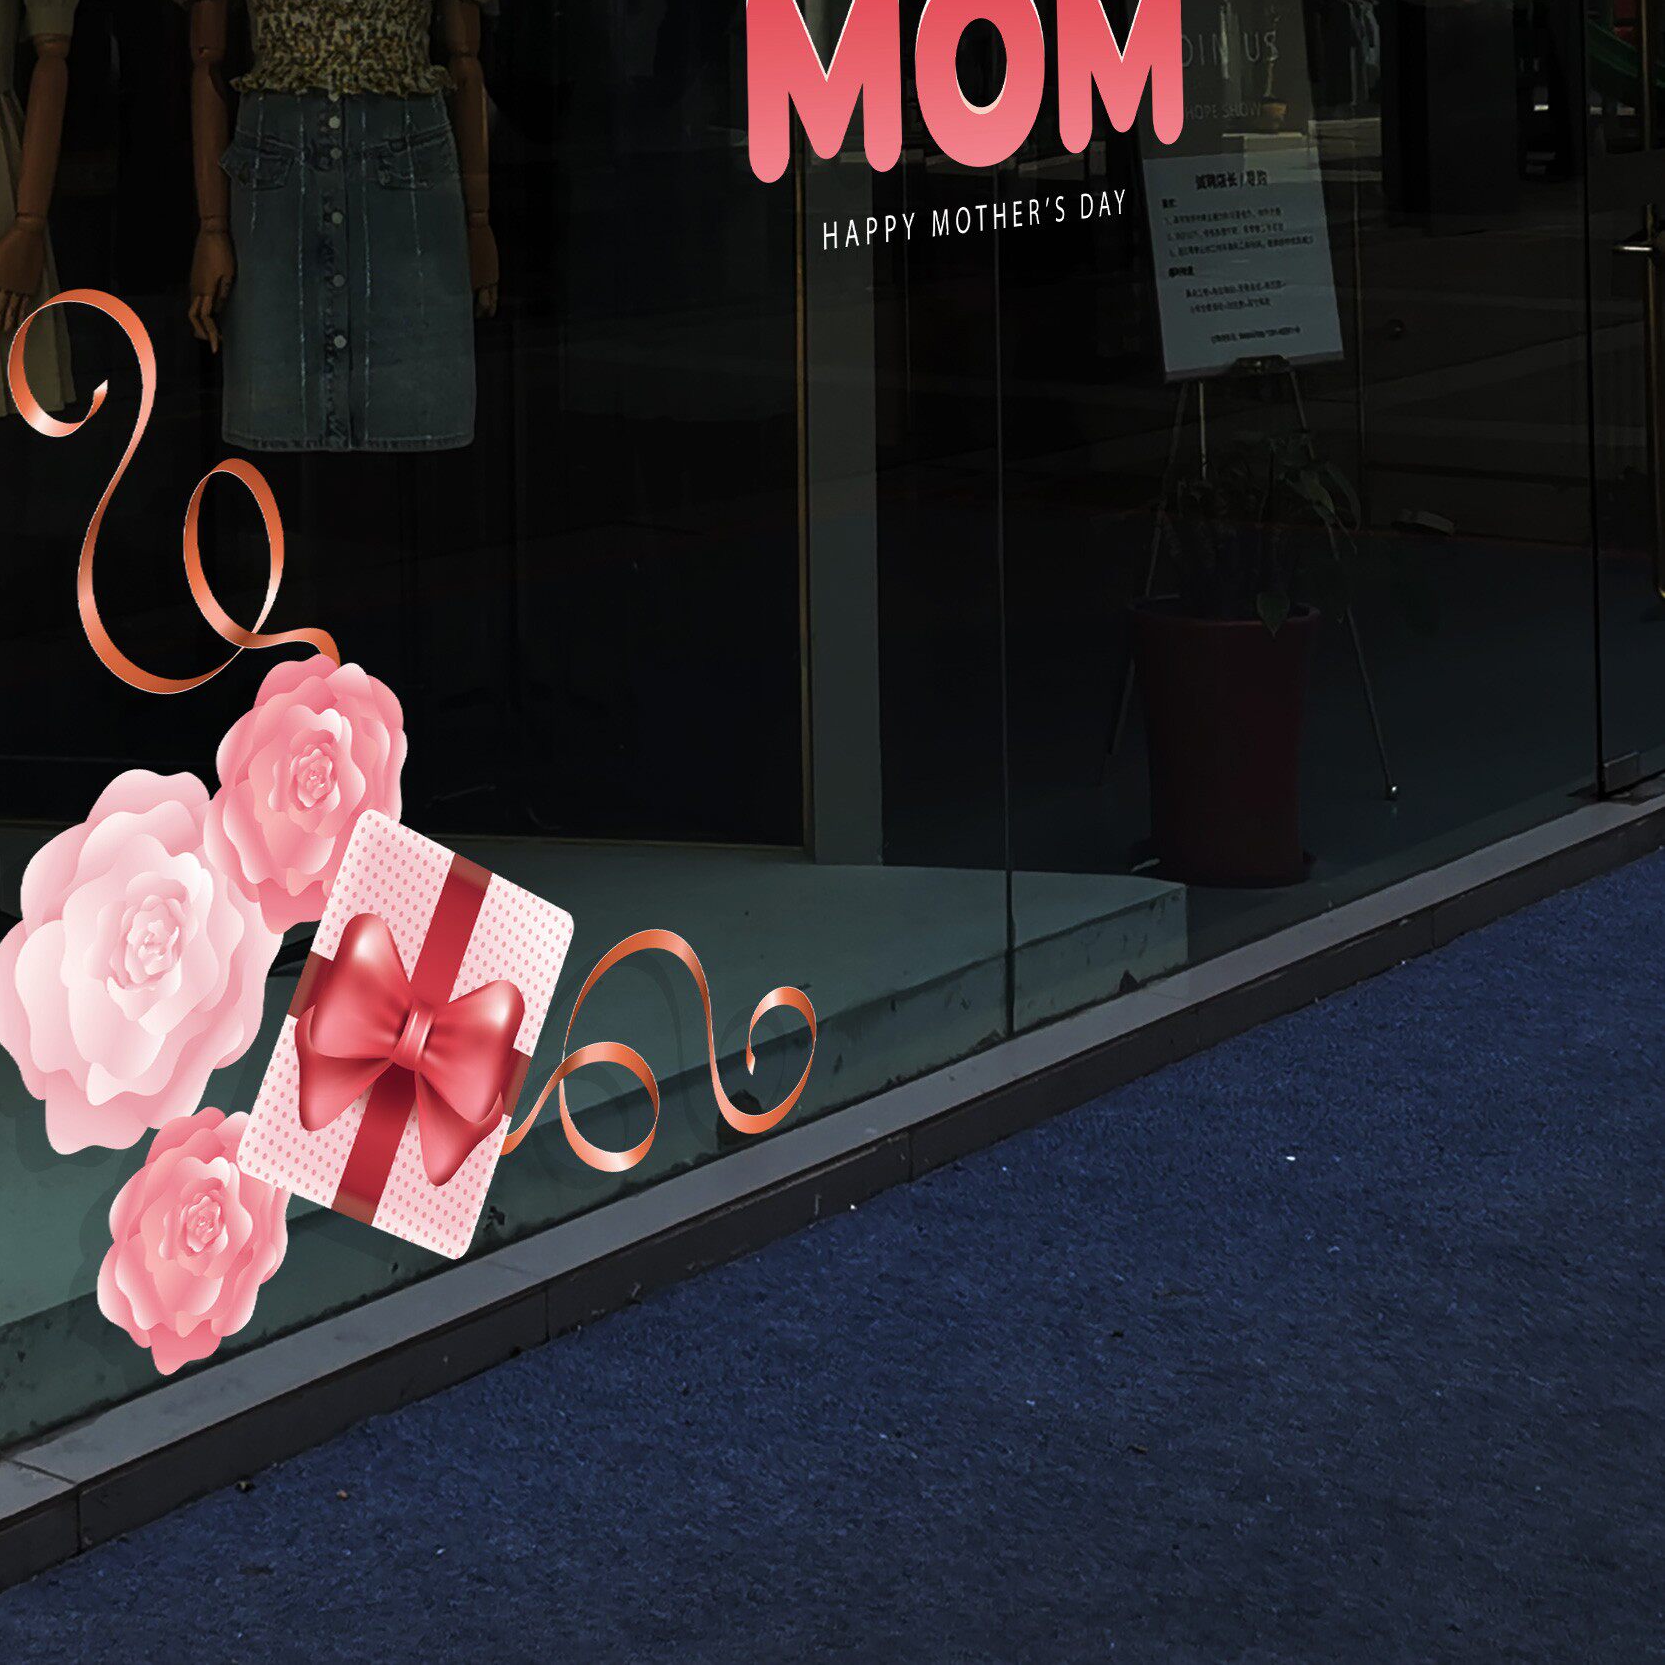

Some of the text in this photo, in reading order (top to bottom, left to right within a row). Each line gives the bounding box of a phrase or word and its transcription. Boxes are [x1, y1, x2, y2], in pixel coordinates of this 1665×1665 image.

[823, 211, 916, 252] HAPPY
[932, 195, 1066, 239] MOTHER’S
[1080, 188, 1127, 223] DAY
